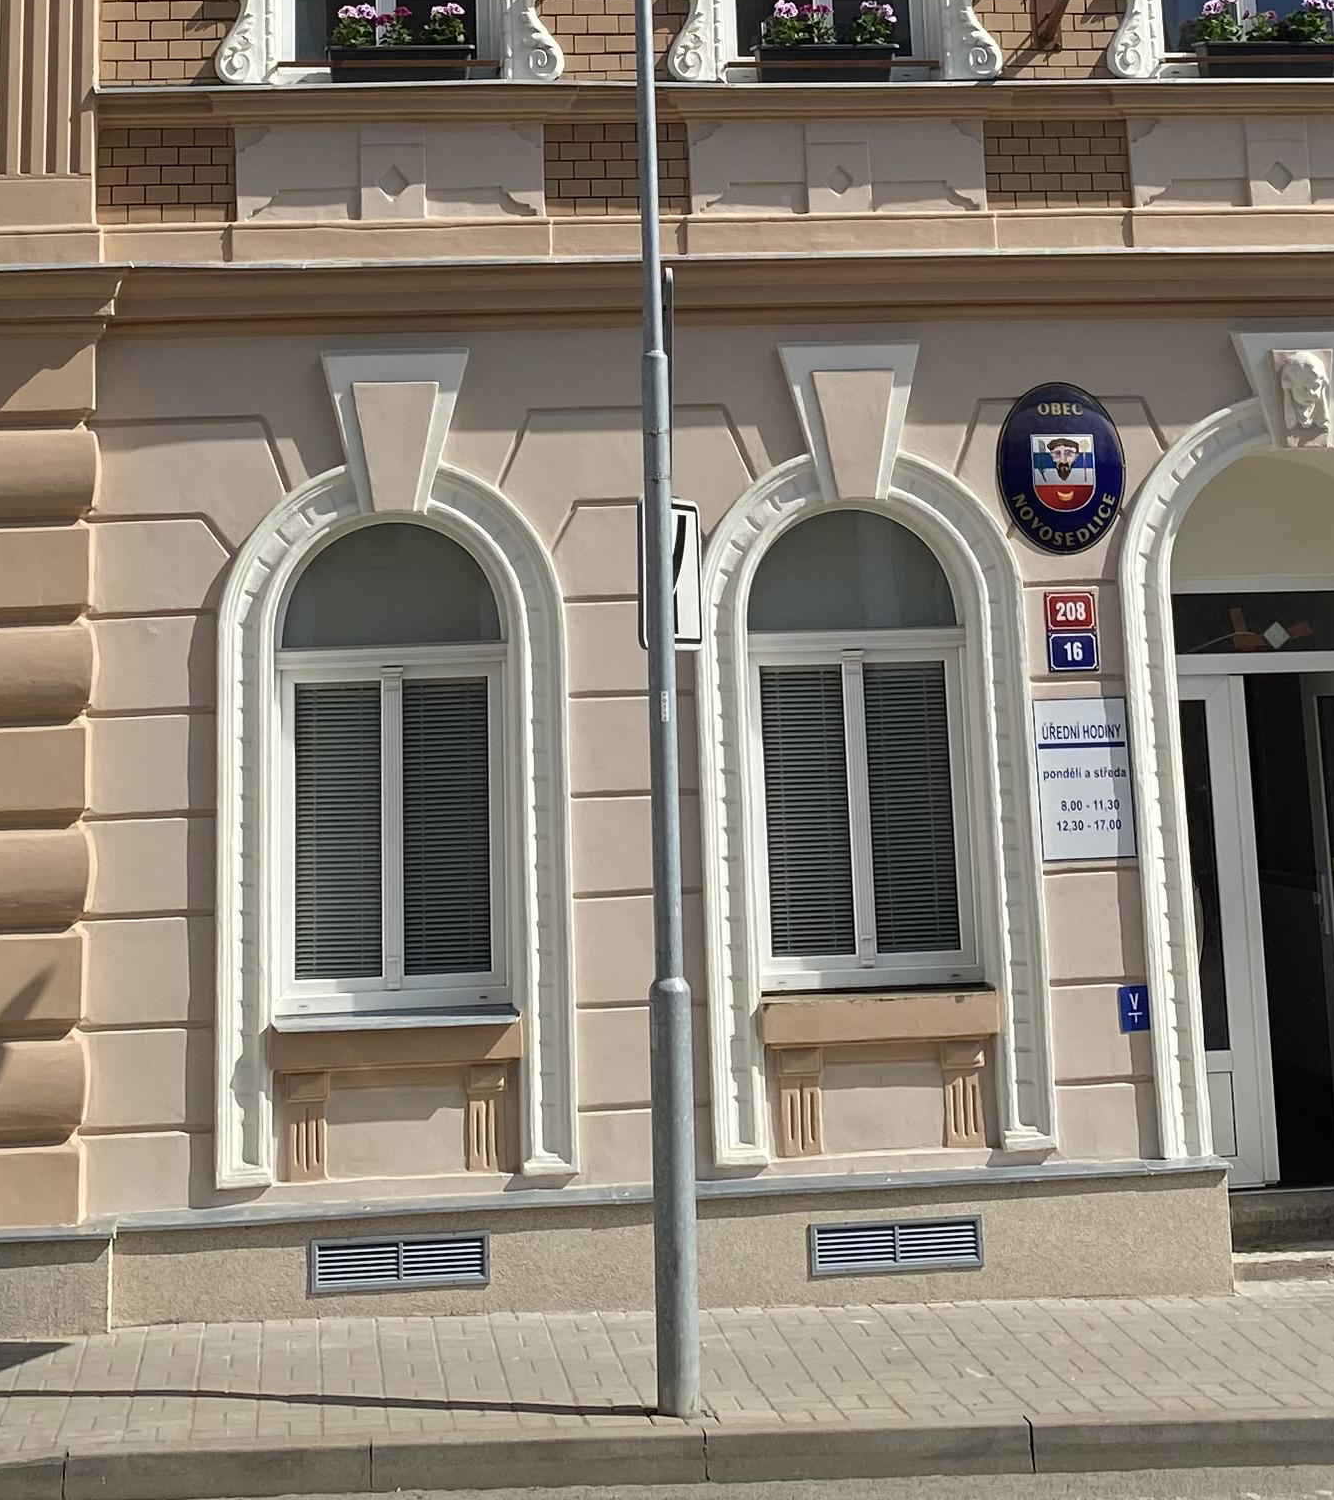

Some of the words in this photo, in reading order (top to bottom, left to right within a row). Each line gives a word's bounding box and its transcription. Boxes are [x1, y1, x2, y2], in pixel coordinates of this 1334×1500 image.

[1037, 402, 1084, 416] OBEC
[1011, 492, 1116, 547] NOVOSEDLICE
[1055, 601, 1086, 621] 208
[1063, 641, 1083, 661] 16
[1041, 721, 1080, 740] ÚŘEDNÍ
[1082, 723, 1121, 739] HODINY
[1043, 767, 1082, 781] pondělí
[1084, 770, 1091, 779] a
[1093, 766, 1127, 778] středa
[1128, 992, 1139, 1010] V
